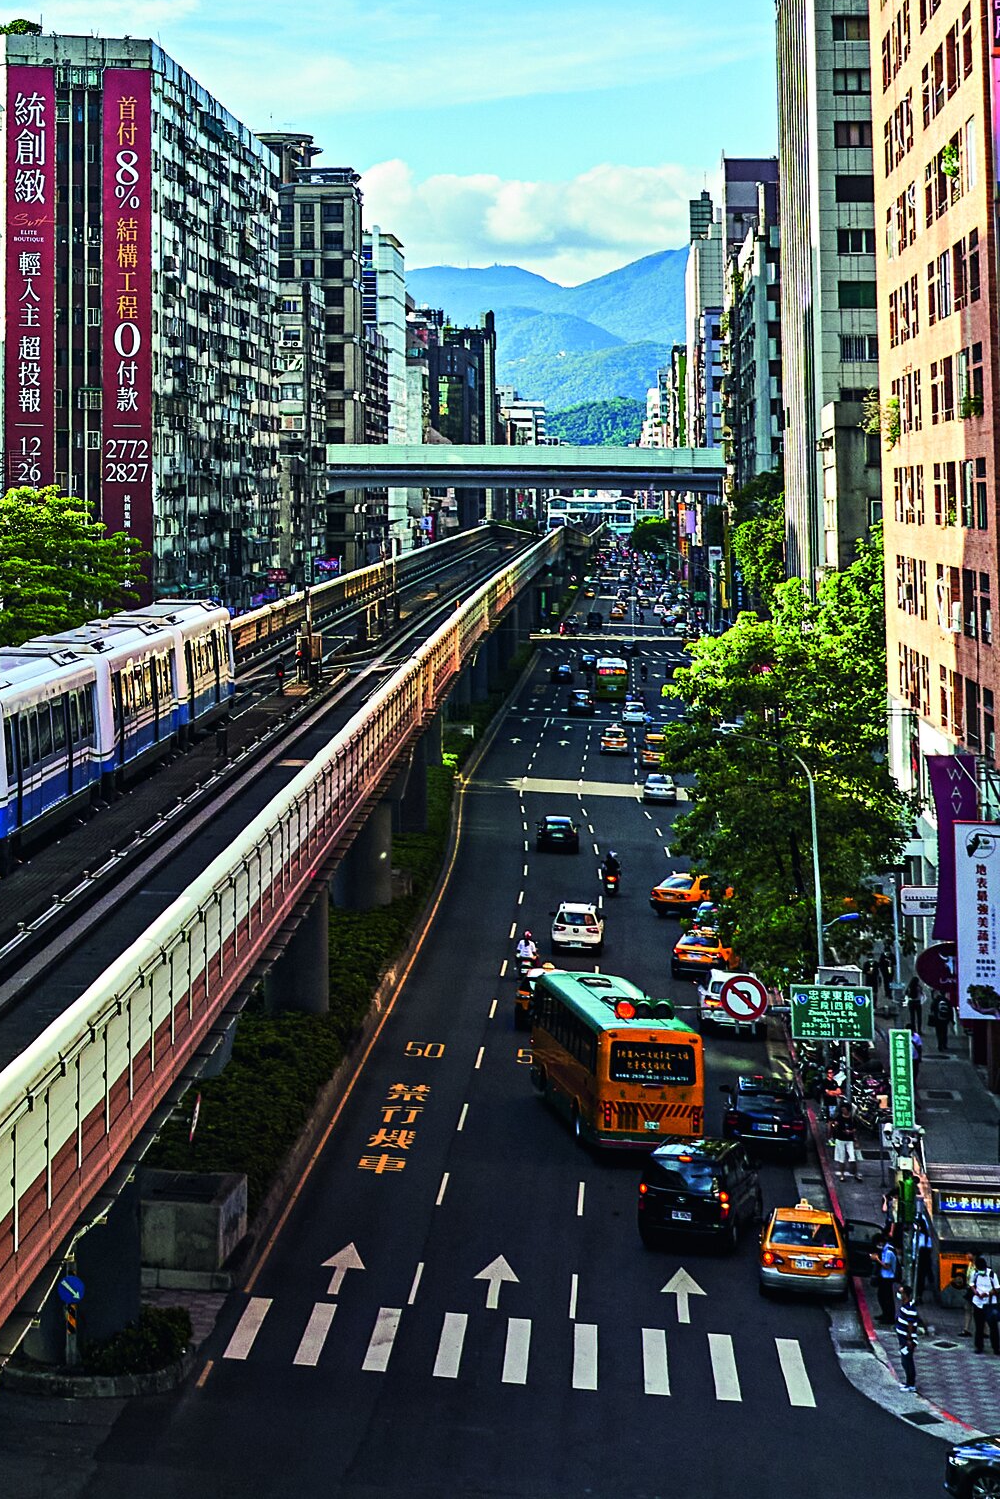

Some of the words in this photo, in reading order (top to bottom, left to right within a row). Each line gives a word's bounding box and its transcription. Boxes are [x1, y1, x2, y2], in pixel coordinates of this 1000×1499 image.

[14, 91, 46, 204] 統創緻
[18, 252, 41, 328] 輕入主
[18, 335, 41, 413] 超投報
[105, 440, 149, 459] 2772
[105, 463, 149, 483] 2827
[808, 990, 854, 1001] 忠孝東路
[404, 1041, 445, 1058] 50
[357, 1083, 431, 1174] 禁行機車
[951, 1263, 969, 1289] 5
